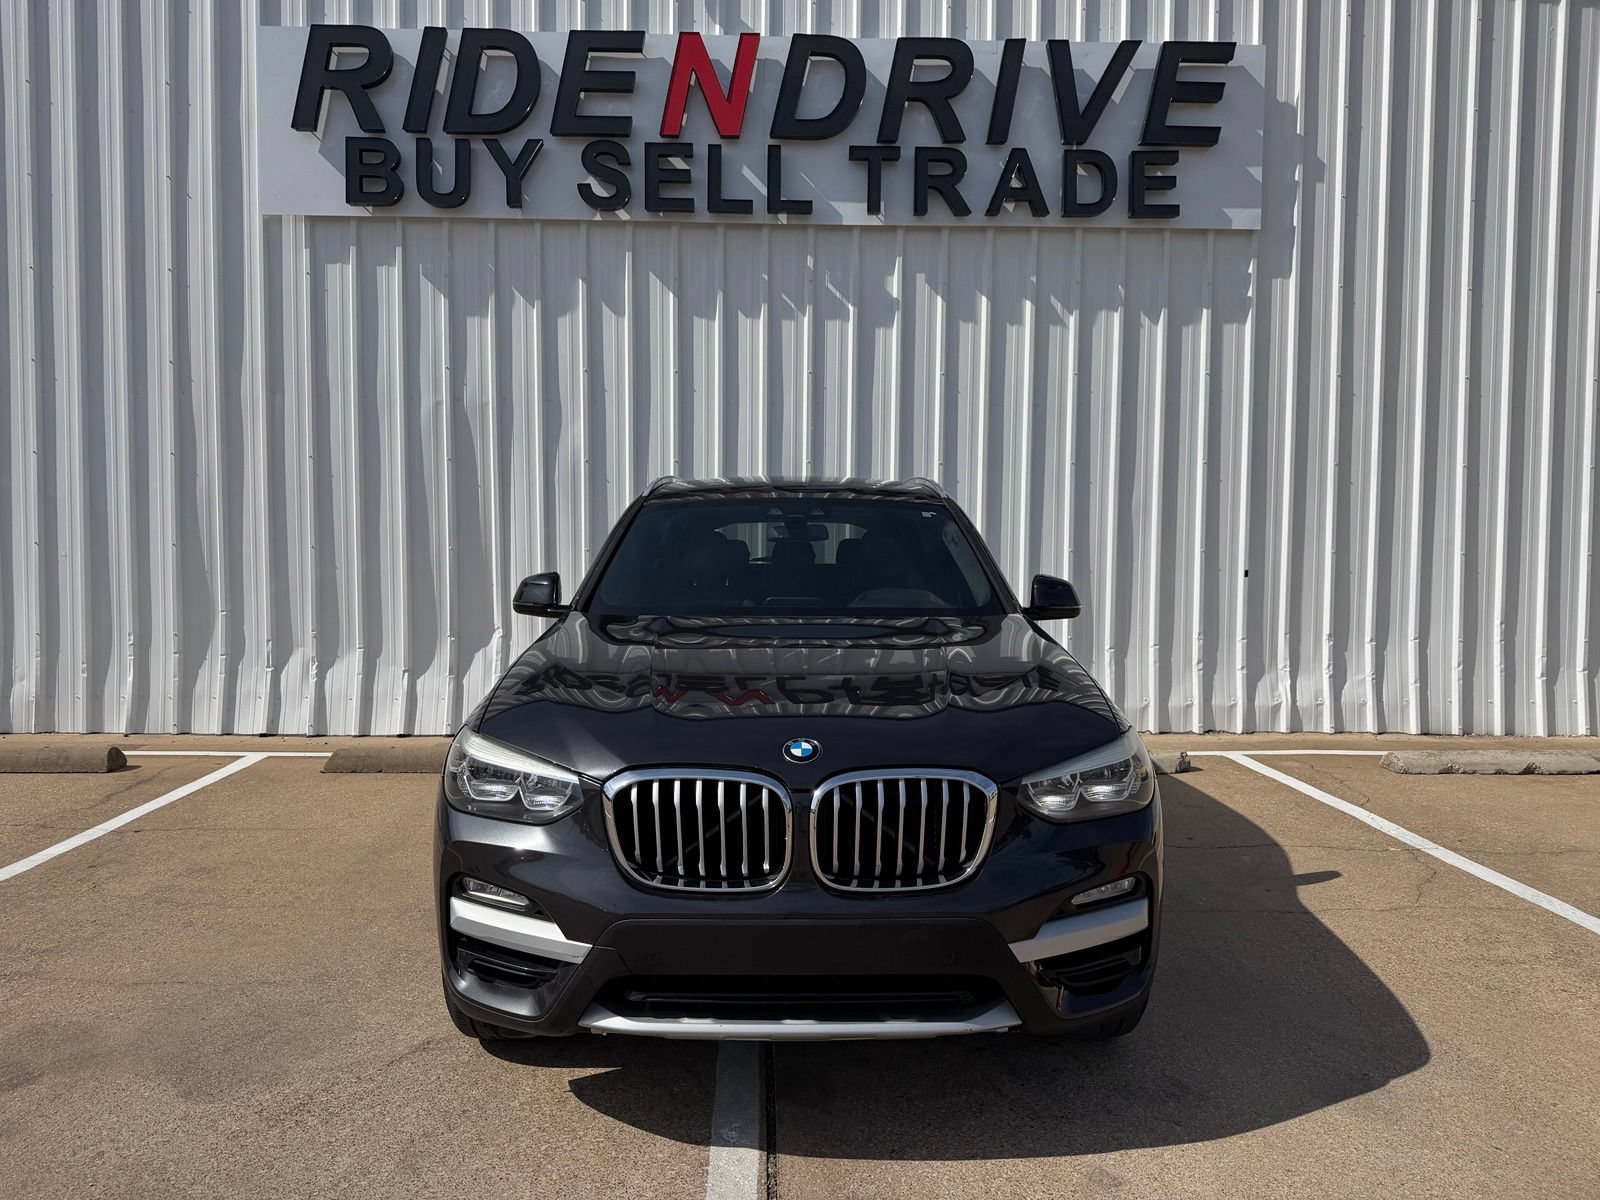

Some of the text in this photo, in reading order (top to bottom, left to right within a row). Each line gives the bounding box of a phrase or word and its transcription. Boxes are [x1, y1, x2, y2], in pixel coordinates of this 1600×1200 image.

[345, 136, 1180, 219] BUY SELL TRADE
